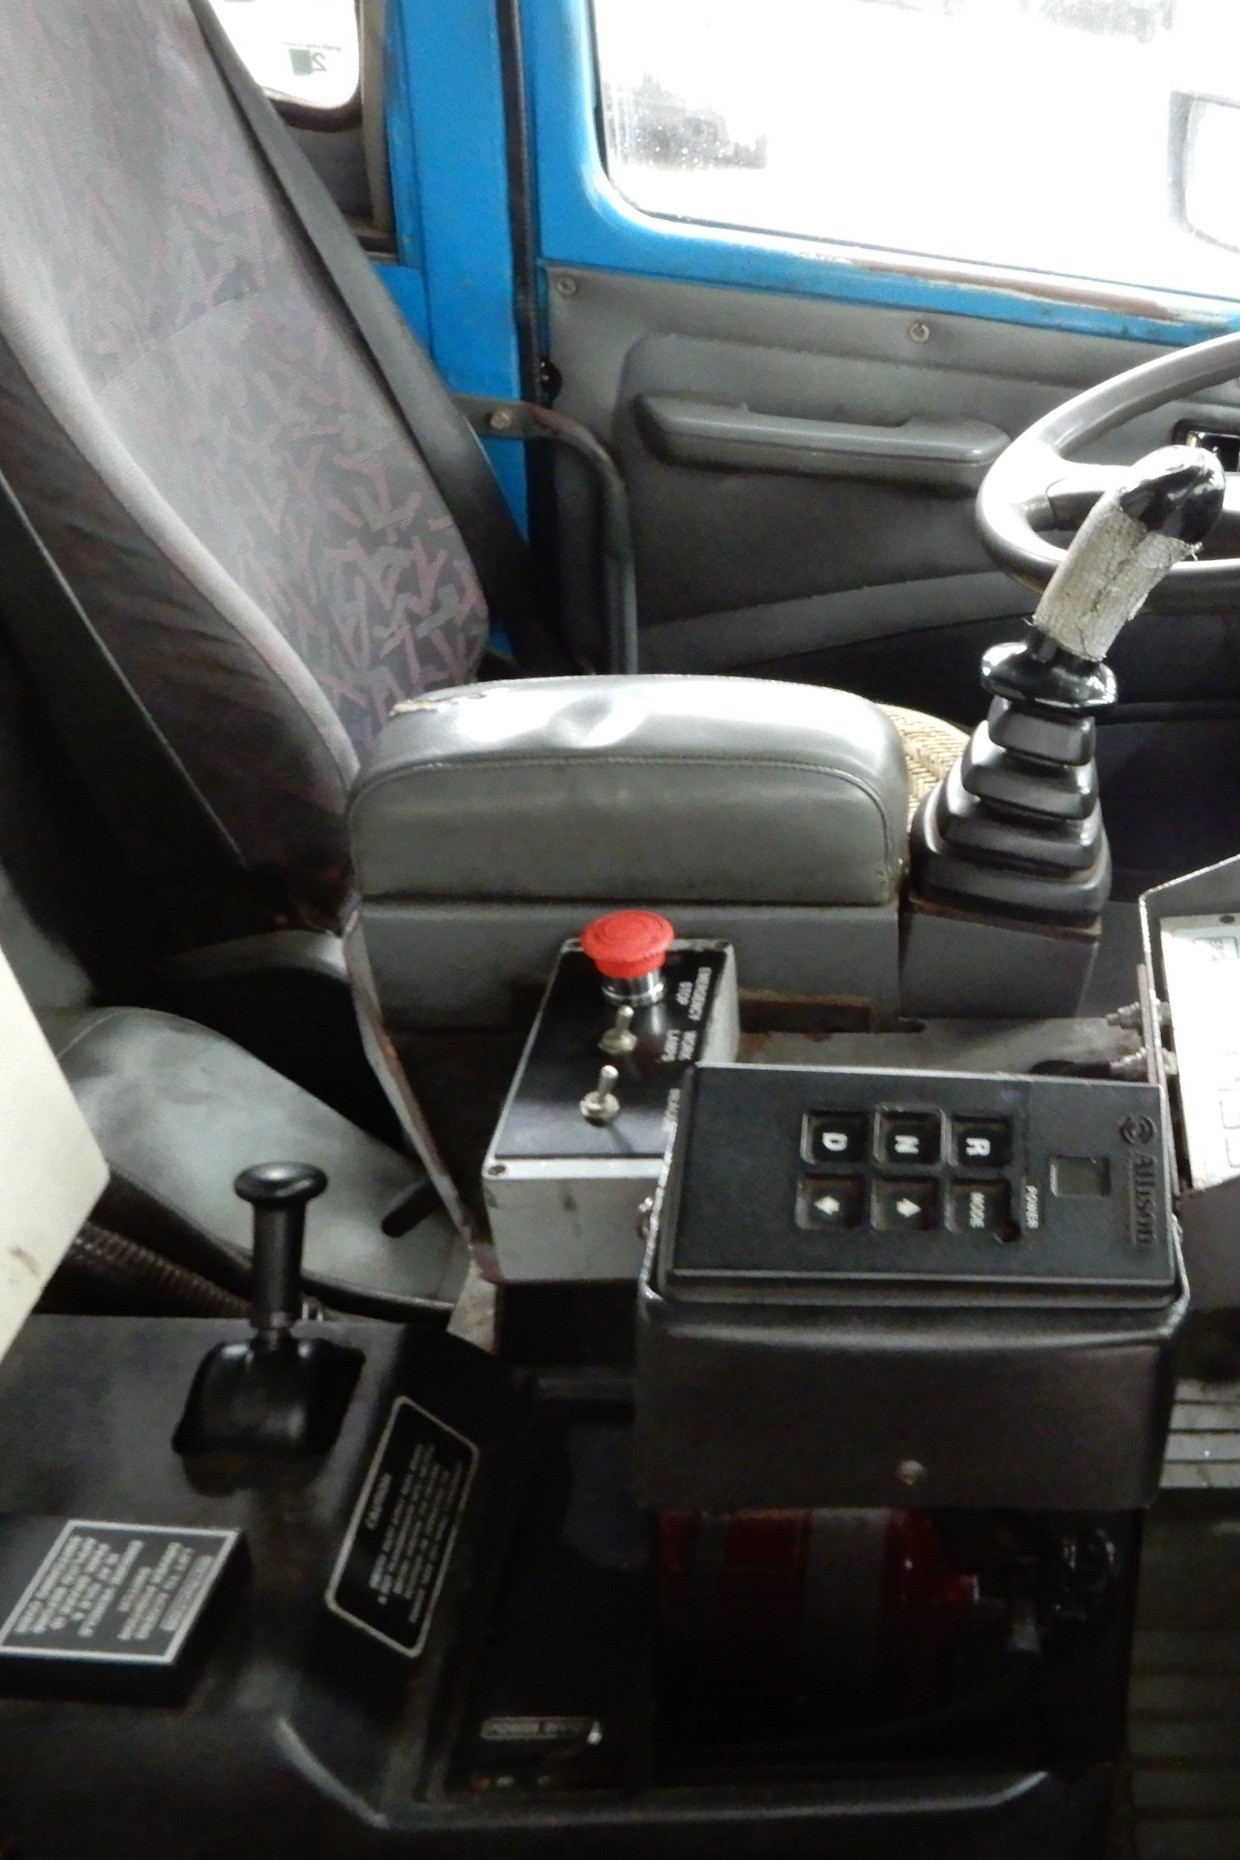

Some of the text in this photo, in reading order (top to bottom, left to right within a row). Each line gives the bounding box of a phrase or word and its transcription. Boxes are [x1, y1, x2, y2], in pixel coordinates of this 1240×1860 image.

[822, 1132, 848, 1151] D
[894, 1135, 919, 1154] N
[966, 1137, 991, 1156] R
[1134, 1153, 1157, 1245] Allison
